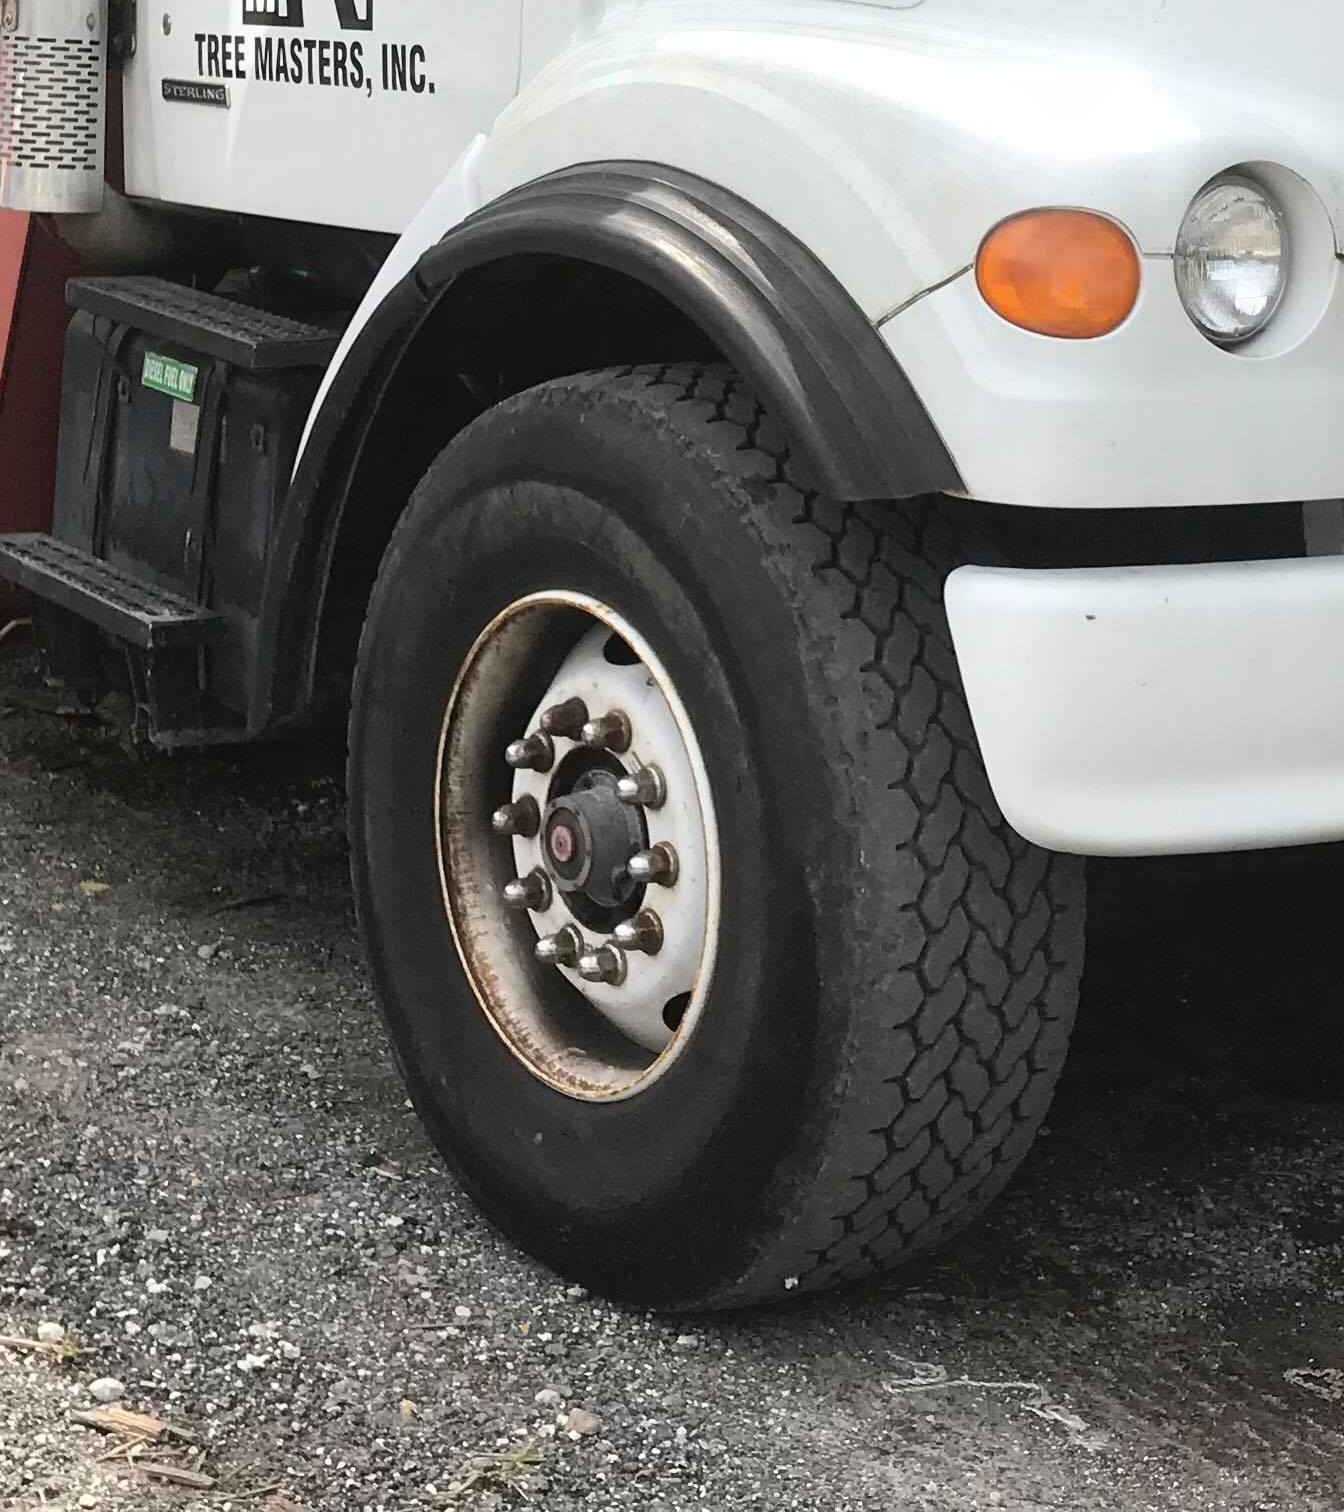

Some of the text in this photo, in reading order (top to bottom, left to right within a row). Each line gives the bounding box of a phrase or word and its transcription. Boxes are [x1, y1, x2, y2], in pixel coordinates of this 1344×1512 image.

[194, 33, 436, 98] TREE MASTERS, INC.
[163, 82, 225, 100] STERLING
